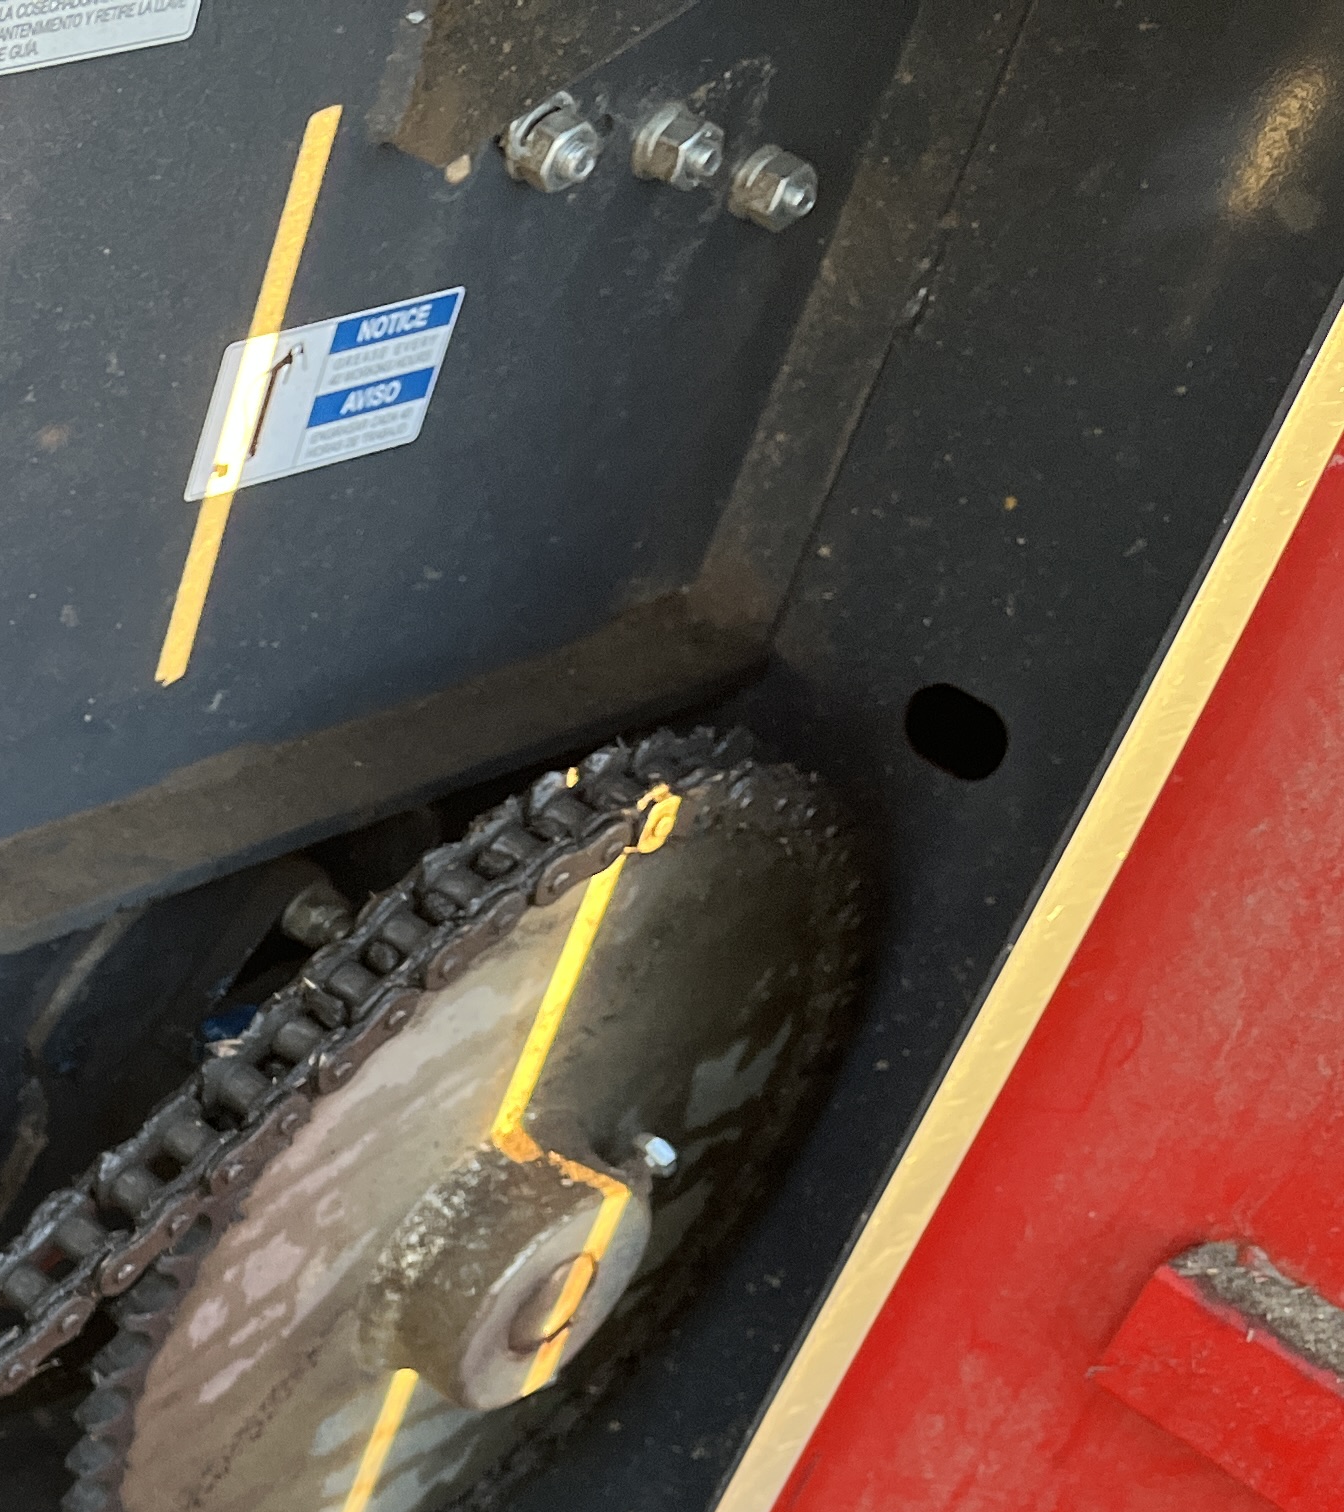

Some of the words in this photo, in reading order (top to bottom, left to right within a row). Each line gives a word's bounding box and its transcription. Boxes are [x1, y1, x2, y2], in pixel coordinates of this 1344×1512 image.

[0, 6, 13, 23] LA
[356, 303, 433, 343] NOTICE
[339, 379, 402, 415] AVISO
